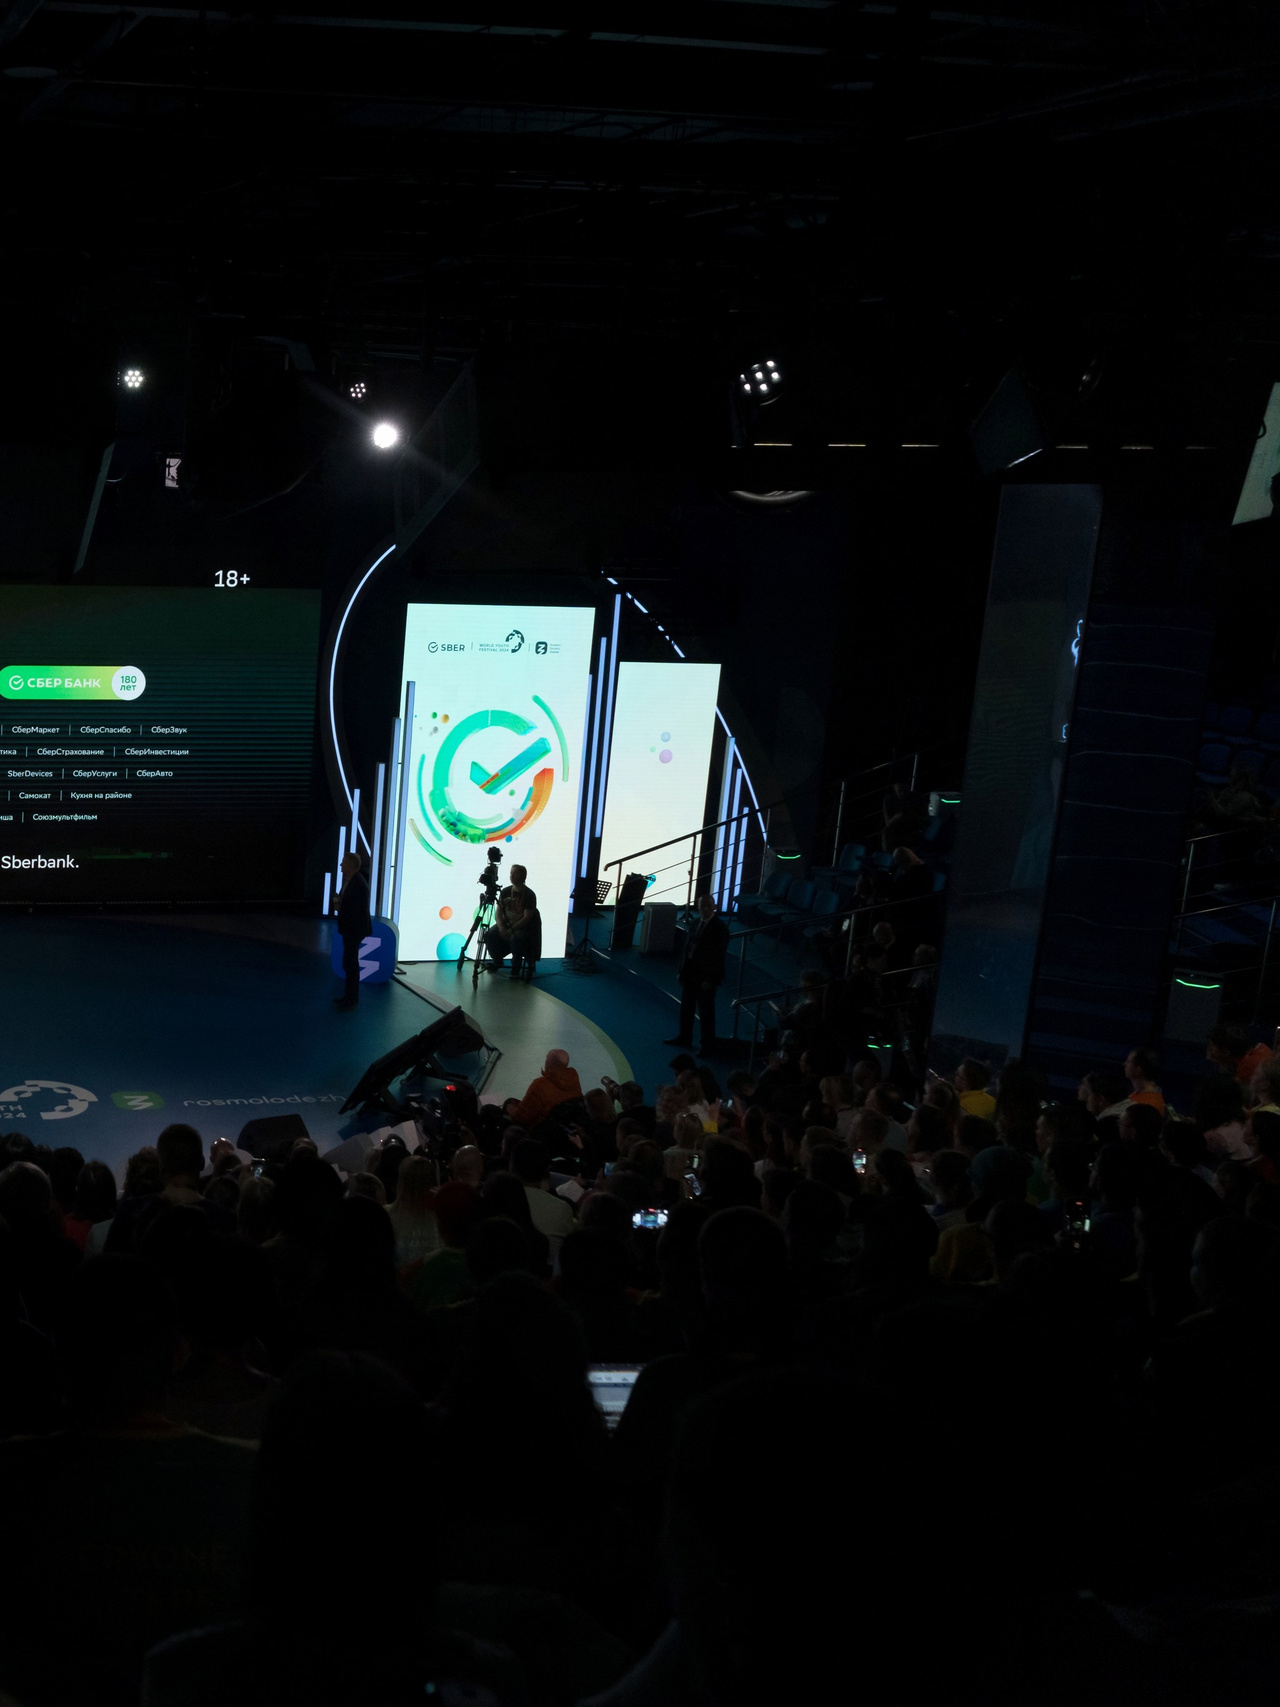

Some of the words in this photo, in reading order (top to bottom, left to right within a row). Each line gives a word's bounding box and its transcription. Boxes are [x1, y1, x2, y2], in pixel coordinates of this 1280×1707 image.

[214, 570, 251, 588] 18+
[440, 643, 466, 652] SBER
[27, 678, 62, 688] СБЕР
[64, 678, 101, 688] БАНК
[120, 675, 137, 684] 180
[11, 725, 60, 736] СберМаркет
[79, 725, 132, 736] СберСпасибо
[150, 725, 188, 736] СберЗвук
[36, 747, 105, 757] СберСтрахование
[124, 747, 190, 757] СберИнвестиции
[7, 769, 53, 779] SberDevices
[72, 769, 118, 779] СберУслуги
[136, 769, 174, 779] СберАвто
[18, 791, 52, 801] Самокат
[70, 791, 93, 801] Кухня
[94, 791, 104, 801] на
[105, 791, 133, 801] районе
[32, 813, 98, 823] Союзмультфильм
[0, 854, 80, 870] Sberbank.
